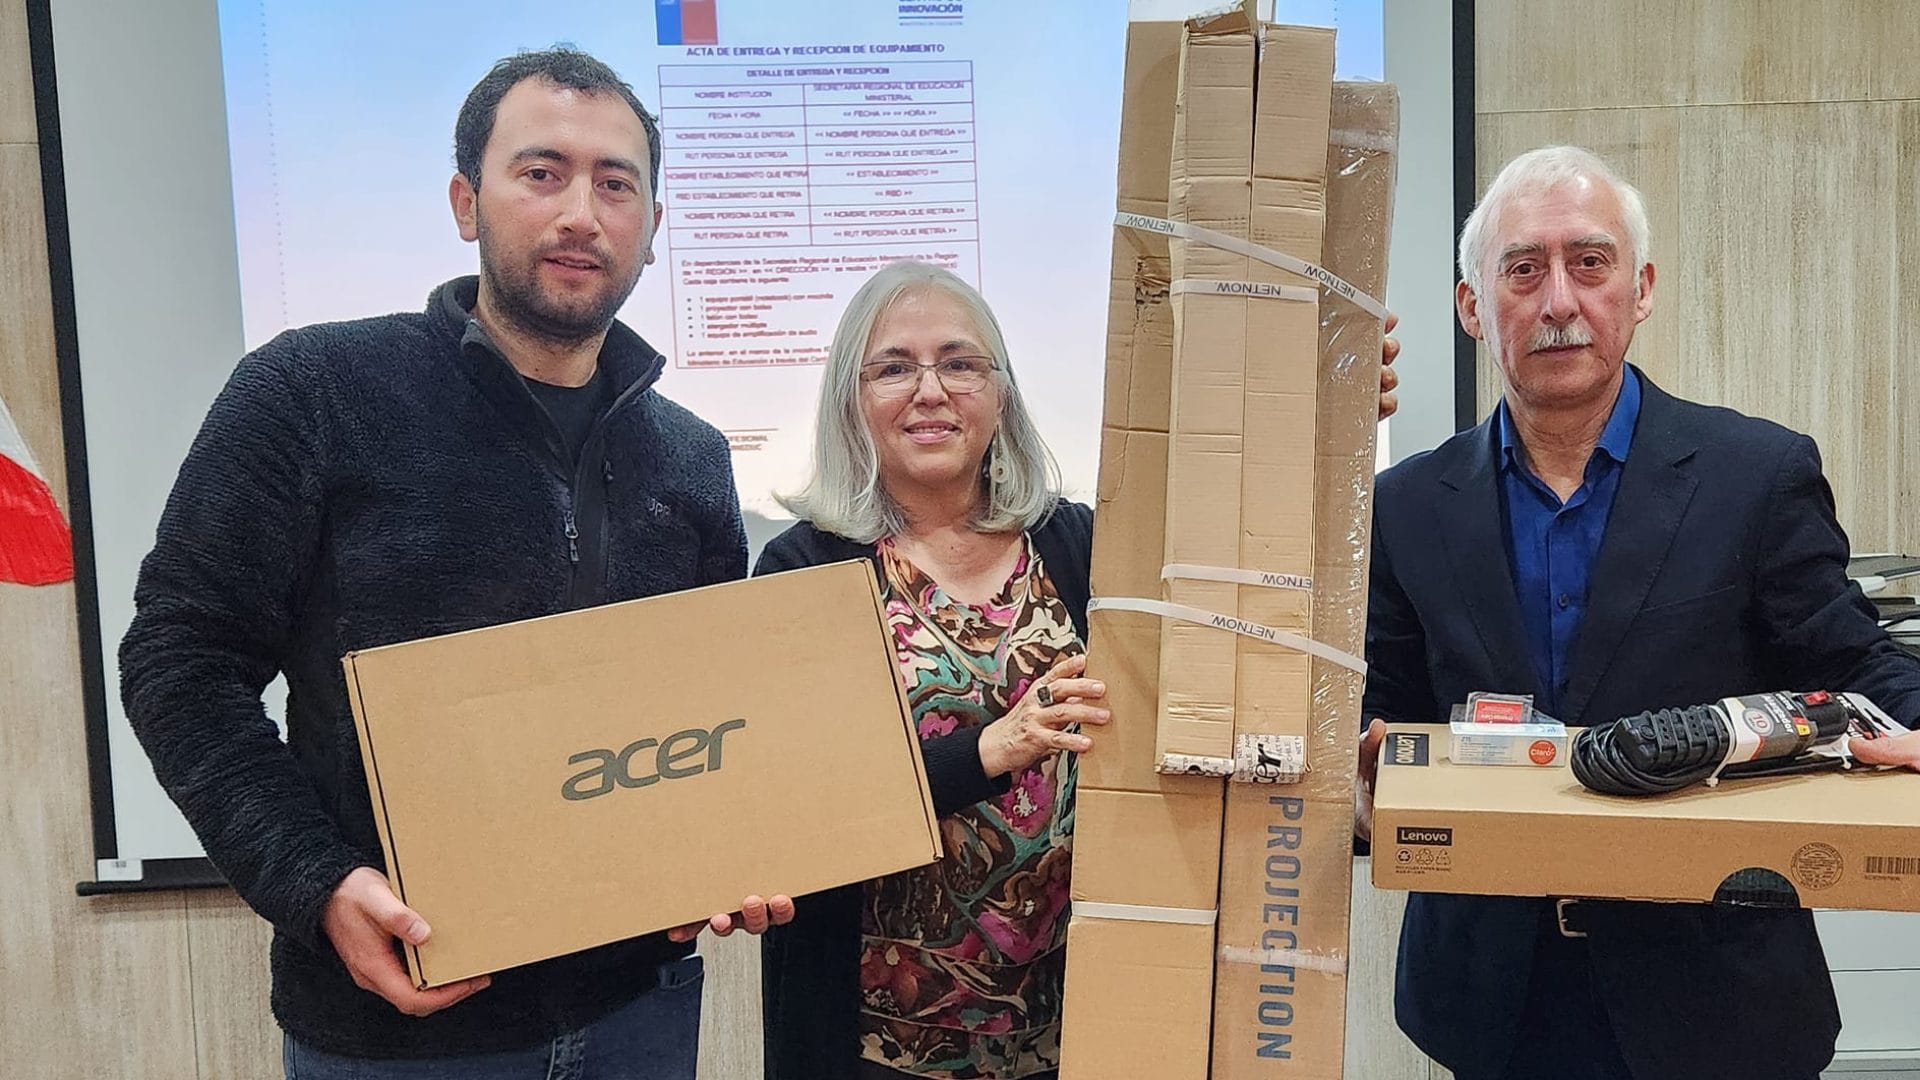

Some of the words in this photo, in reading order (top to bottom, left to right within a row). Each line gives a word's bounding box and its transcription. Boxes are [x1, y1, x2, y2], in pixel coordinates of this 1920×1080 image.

[899, 3, 963, 13] INNOVACIÓN
[686, 47, 714, 56] ACTA
[716, 47, 729, 56] DE
[733, 46, 780, 56] ENTREGA
[783, 46, 790, 55] Y
[852, 45, 866, 54] DE
[869, 43, 944, 54] EQUIPAMIENTO
[561, 718, 747, 801] acer
[1394, 734, 1421, 764] Lenovo
[1401, 829, 1448, 842] Lenovo
[1256, 796, 1304, 1060] PROJECTION
